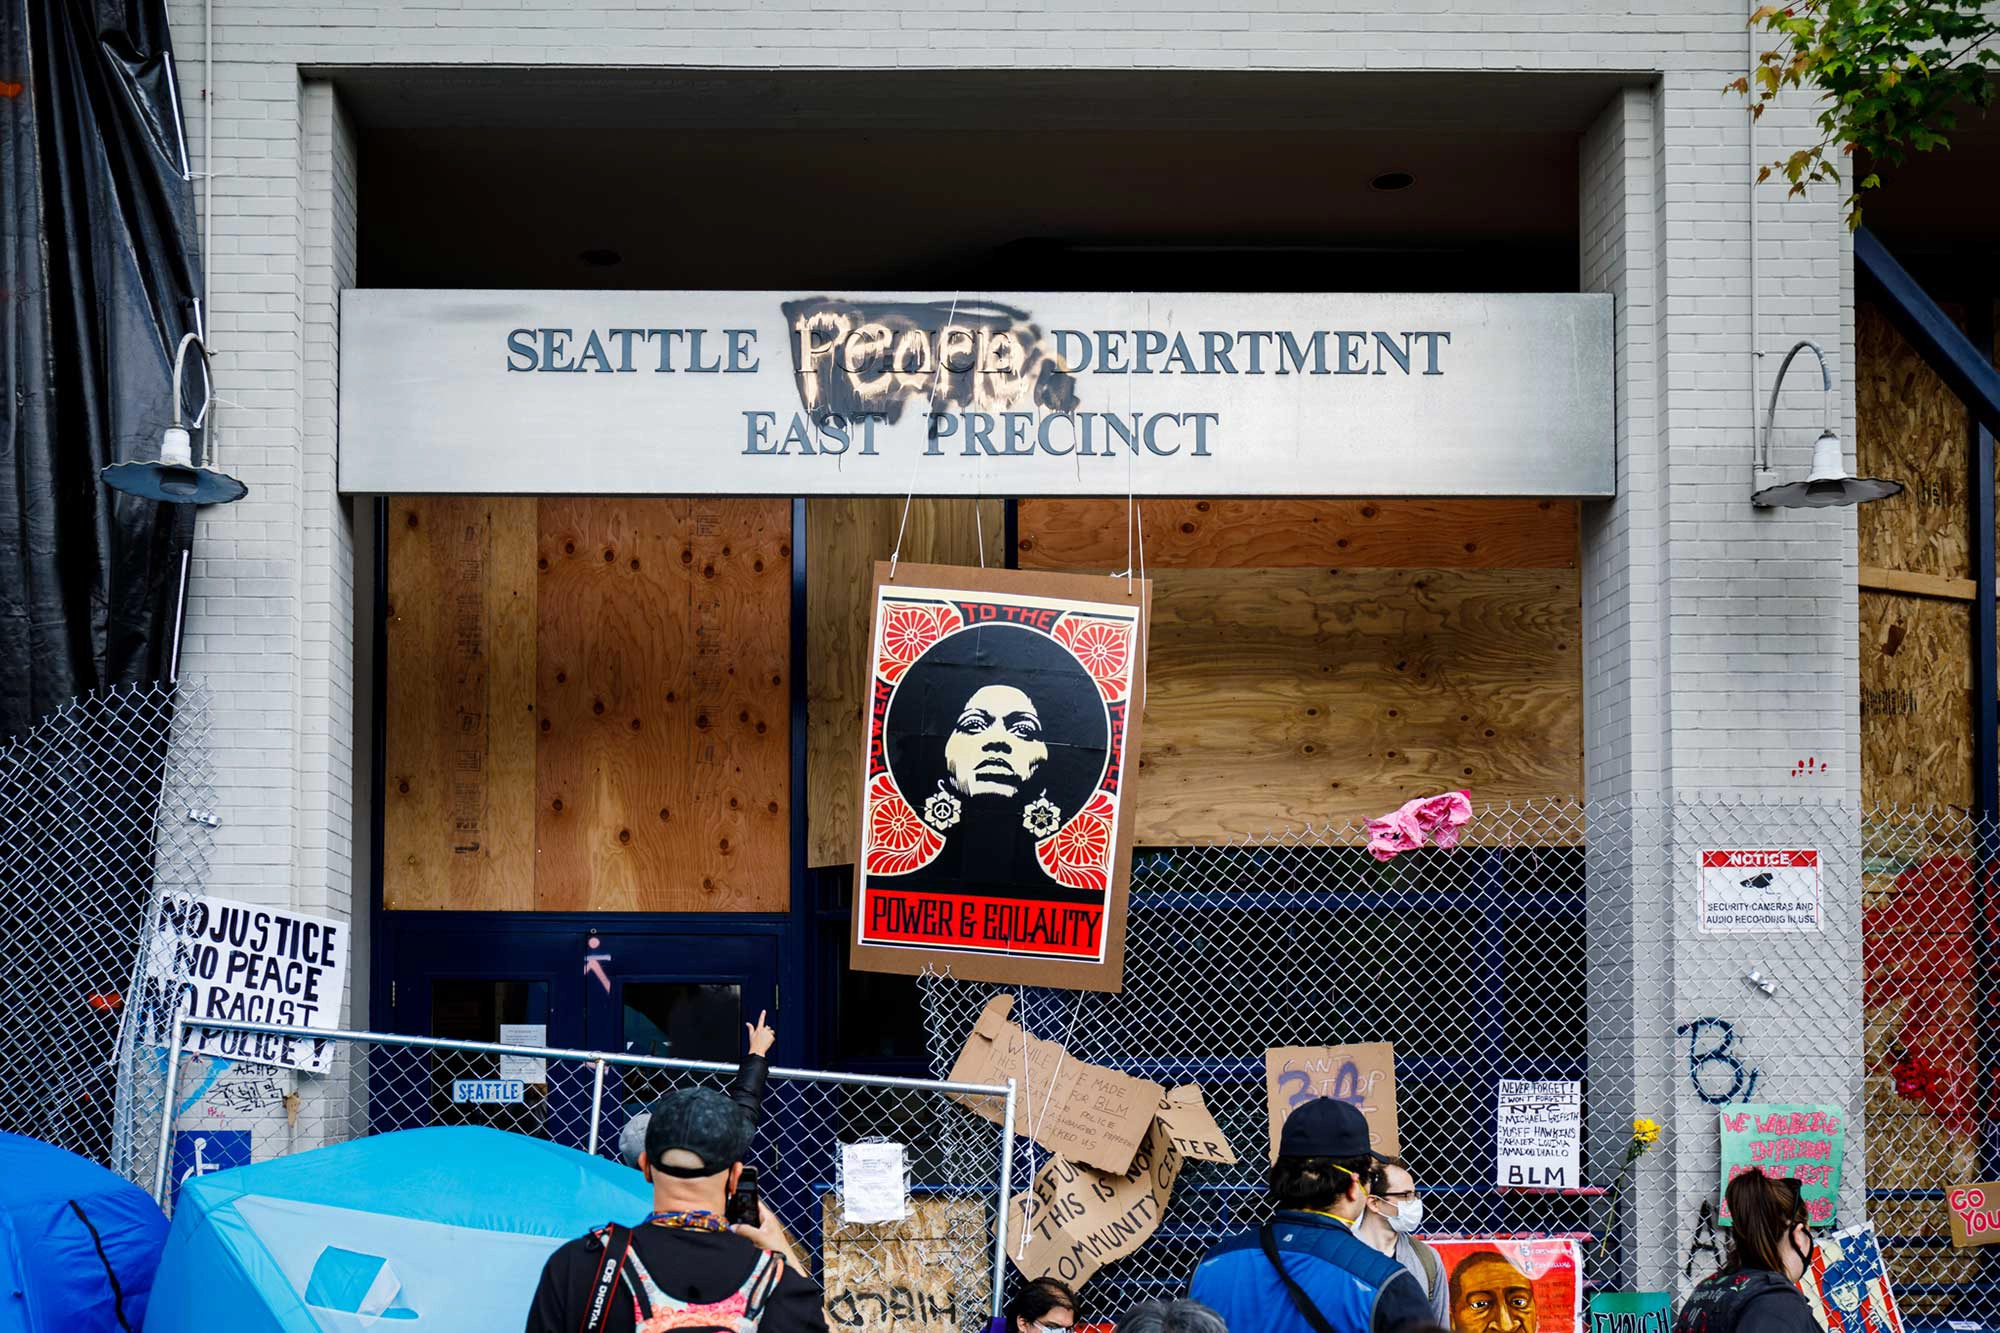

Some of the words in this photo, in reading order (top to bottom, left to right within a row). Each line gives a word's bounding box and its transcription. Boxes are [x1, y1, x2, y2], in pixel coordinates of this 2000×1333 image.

[507, 328, 759, 373] SEATTLE
[1050, 329, 1451, 376] DEPARTMENT
[741, 410, 887, 456] EAST
[922, 411, 1219, 457] PRECINCT
[870, 681, 892, 774] POWER
[960, 603, 997, 623] TO
[1002, 606, 1058, 631] THE
[1102, 704, 1126, 790] PEOPLE
[1730, 853, 1790, 865] NOTICE
[1707, 902, 1749, 911] SECURITY
[1752, 902, 1794, 911] CAMERAS
[1795, 902, 1814, 911] AND
[872, 896, 952, 937] POWER
[960, 902, 976, 938] &
[983, 903, 1102, 948] EQUALITY
[1706, 915, 1733, 924] AUDIO
[1735, 915, 1785, 924] RECORDING
[1788, 915, 1797, 924] IN
[1798, 915, 1816, 924] USE
[159, 896, 209, 939] NO
[209, 907, 337, 968] JUSTICE
[173, 941, 219, 980] NO
[225, 951, 322, 1002] PEACE
[206, 986, 319, 1028] RACIST
[459, 1083, 519, 1100] SEATTLE
[1091, 1078, 1127, 1098] MADE
[1501, 1081, 1529, 1094] NEVER
[1094, 1096, 1129, 1117] BLM
[1511, 1104, 1561, 1114] NYC
[1080, 1111, 1116, 1130] POLICE
[1505, 1114, 1547, 1124] MICHAEL
[1721, 1112, 1751, 1133] WE
[1534, 1126, 1576, 1139] HAWKINS
[1033, 1192, 1086, 1240] THIS
[1091, 1177, 1115, 1203] IS
[1156, 1116, 1174, 1138] A
[1508, 1165, 1565, 1186] BLM
[1951, 1189, 1985, 1211] GO
[1042, 1189, 1159, 1281] OMMUNITY
[602, 1258, 617, 1283] EOS
[588, 1284, 608, 1330] DIGITAL
